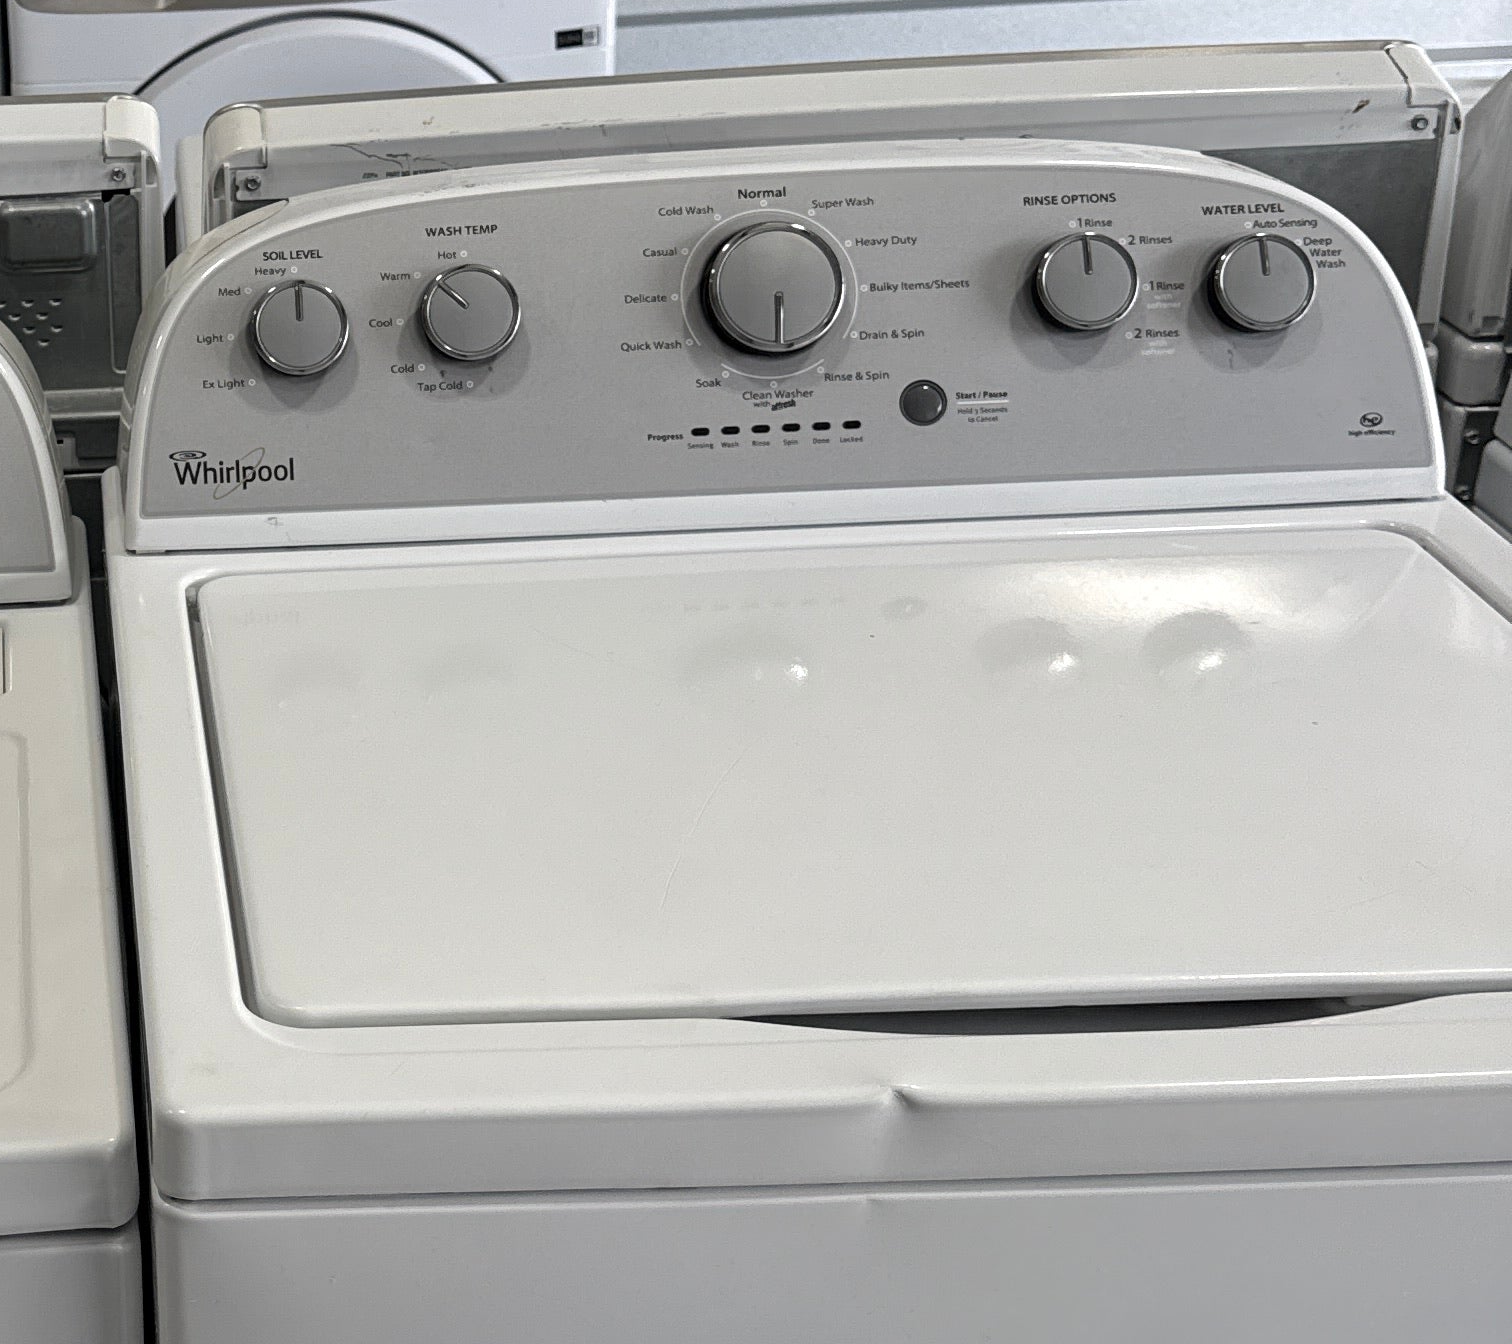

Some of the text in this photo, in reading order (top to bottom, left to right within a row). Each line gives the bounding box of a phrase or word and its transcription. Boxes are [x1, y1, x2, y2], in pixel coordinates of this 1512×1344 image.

[738, 187, 786, 199] Normal
[812, 197, 874, 209] Super Wash
[1023, 193, 1116, 206] RINSE OPTIONS
[658, 206, 713, 216] Cold Wash
[1202, 203, 1284, 215] WATER LEVEL
[1077, 218, 1112, 228] 1 Rinse
[1253, 219, 1317, 228] Auto Sensing
[425, 225, 497, 237] WASH TEMP
[856, 236, 917, 247] Heavy Duty
[1128, 235, 1172, 245] 2 Rinses
[1303, 237, 1332, 247] Deep
[263, 250, 323, 261] SOIL LEVEL
[438, 251, 456, 259] Hot
[643, 247, 677, 257] Casual
[1310, 248, 1342, 257] Water
[1316, 259, 1346, 268] Wash
[255, 268, 286, 276] Heavy
[380, 273, 410, 281] Warm
[870, 280, 970, 292] Bulky Items/Sheets
[1149, 280, 1184, 291] 1 Rinse
[219, 287, 241, 296] Med
[625, 294, 667, 303] Delicate
[369, 318, 392, 327] Cool
[860, 329, 924, 340] Drain & Spin
[1134, 328, 1180, 339] 2 Rinses
[197, 334, 224, 345] Light
[621, 340, 682, 352] Quick Wash
[391, 363, 414, 373] Cold
[824, 371, 889, 382] Rinse & Spin
[203, 378, 245, 390] Ex Light
[417, 381, 463, 393] Tap Cold
[696, 378, 722, 388] Soak
[743, 388, 813, 400] Clean Washer
[955, 392, 977, 400] Start
[648, 434, 683, 442] Progress
[173, 457, 295, 489] Whirlpool
